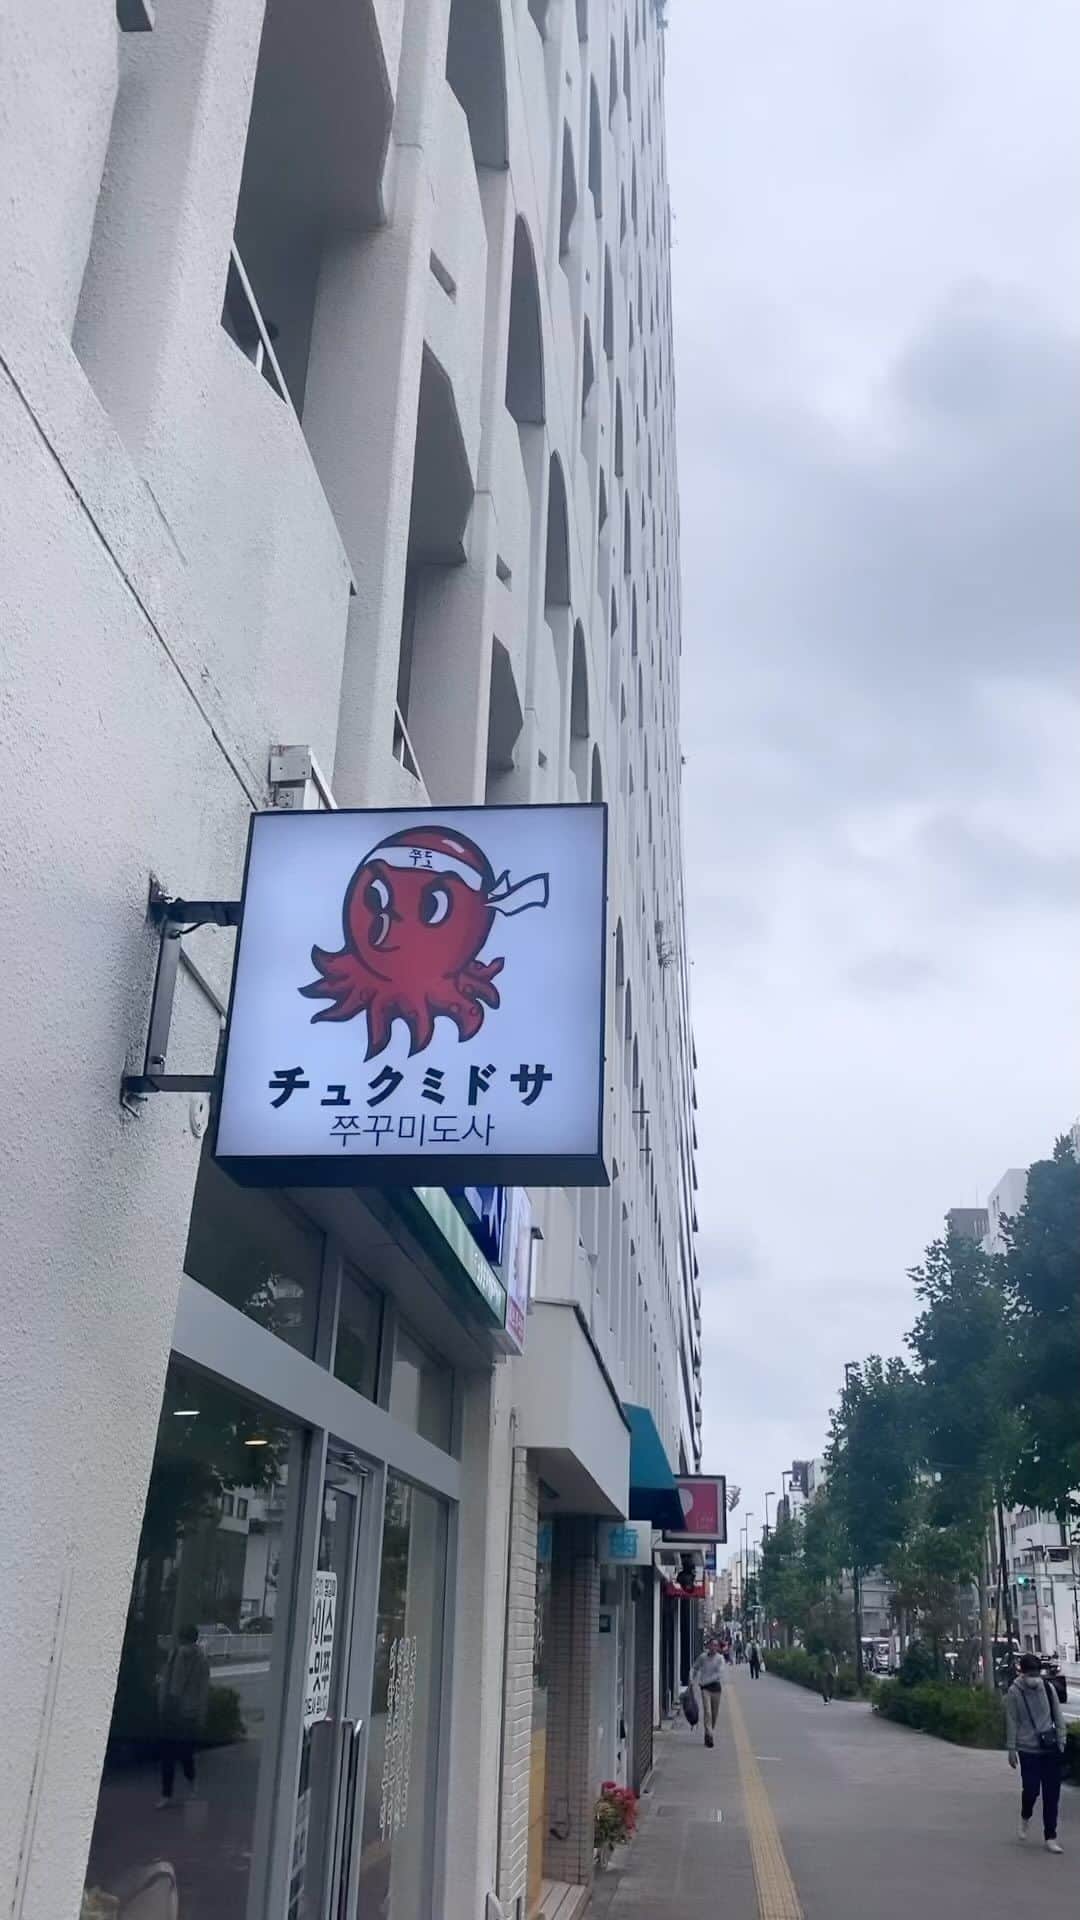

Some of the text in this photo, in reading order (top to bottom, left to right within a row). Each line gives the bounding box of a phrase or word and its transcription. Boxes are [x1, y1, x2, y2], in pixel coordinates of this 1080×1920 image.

[268, 1064, 553, 1109] チュクミドサ
[329, 1113, 496, 1148] 쭈꾸미도사
